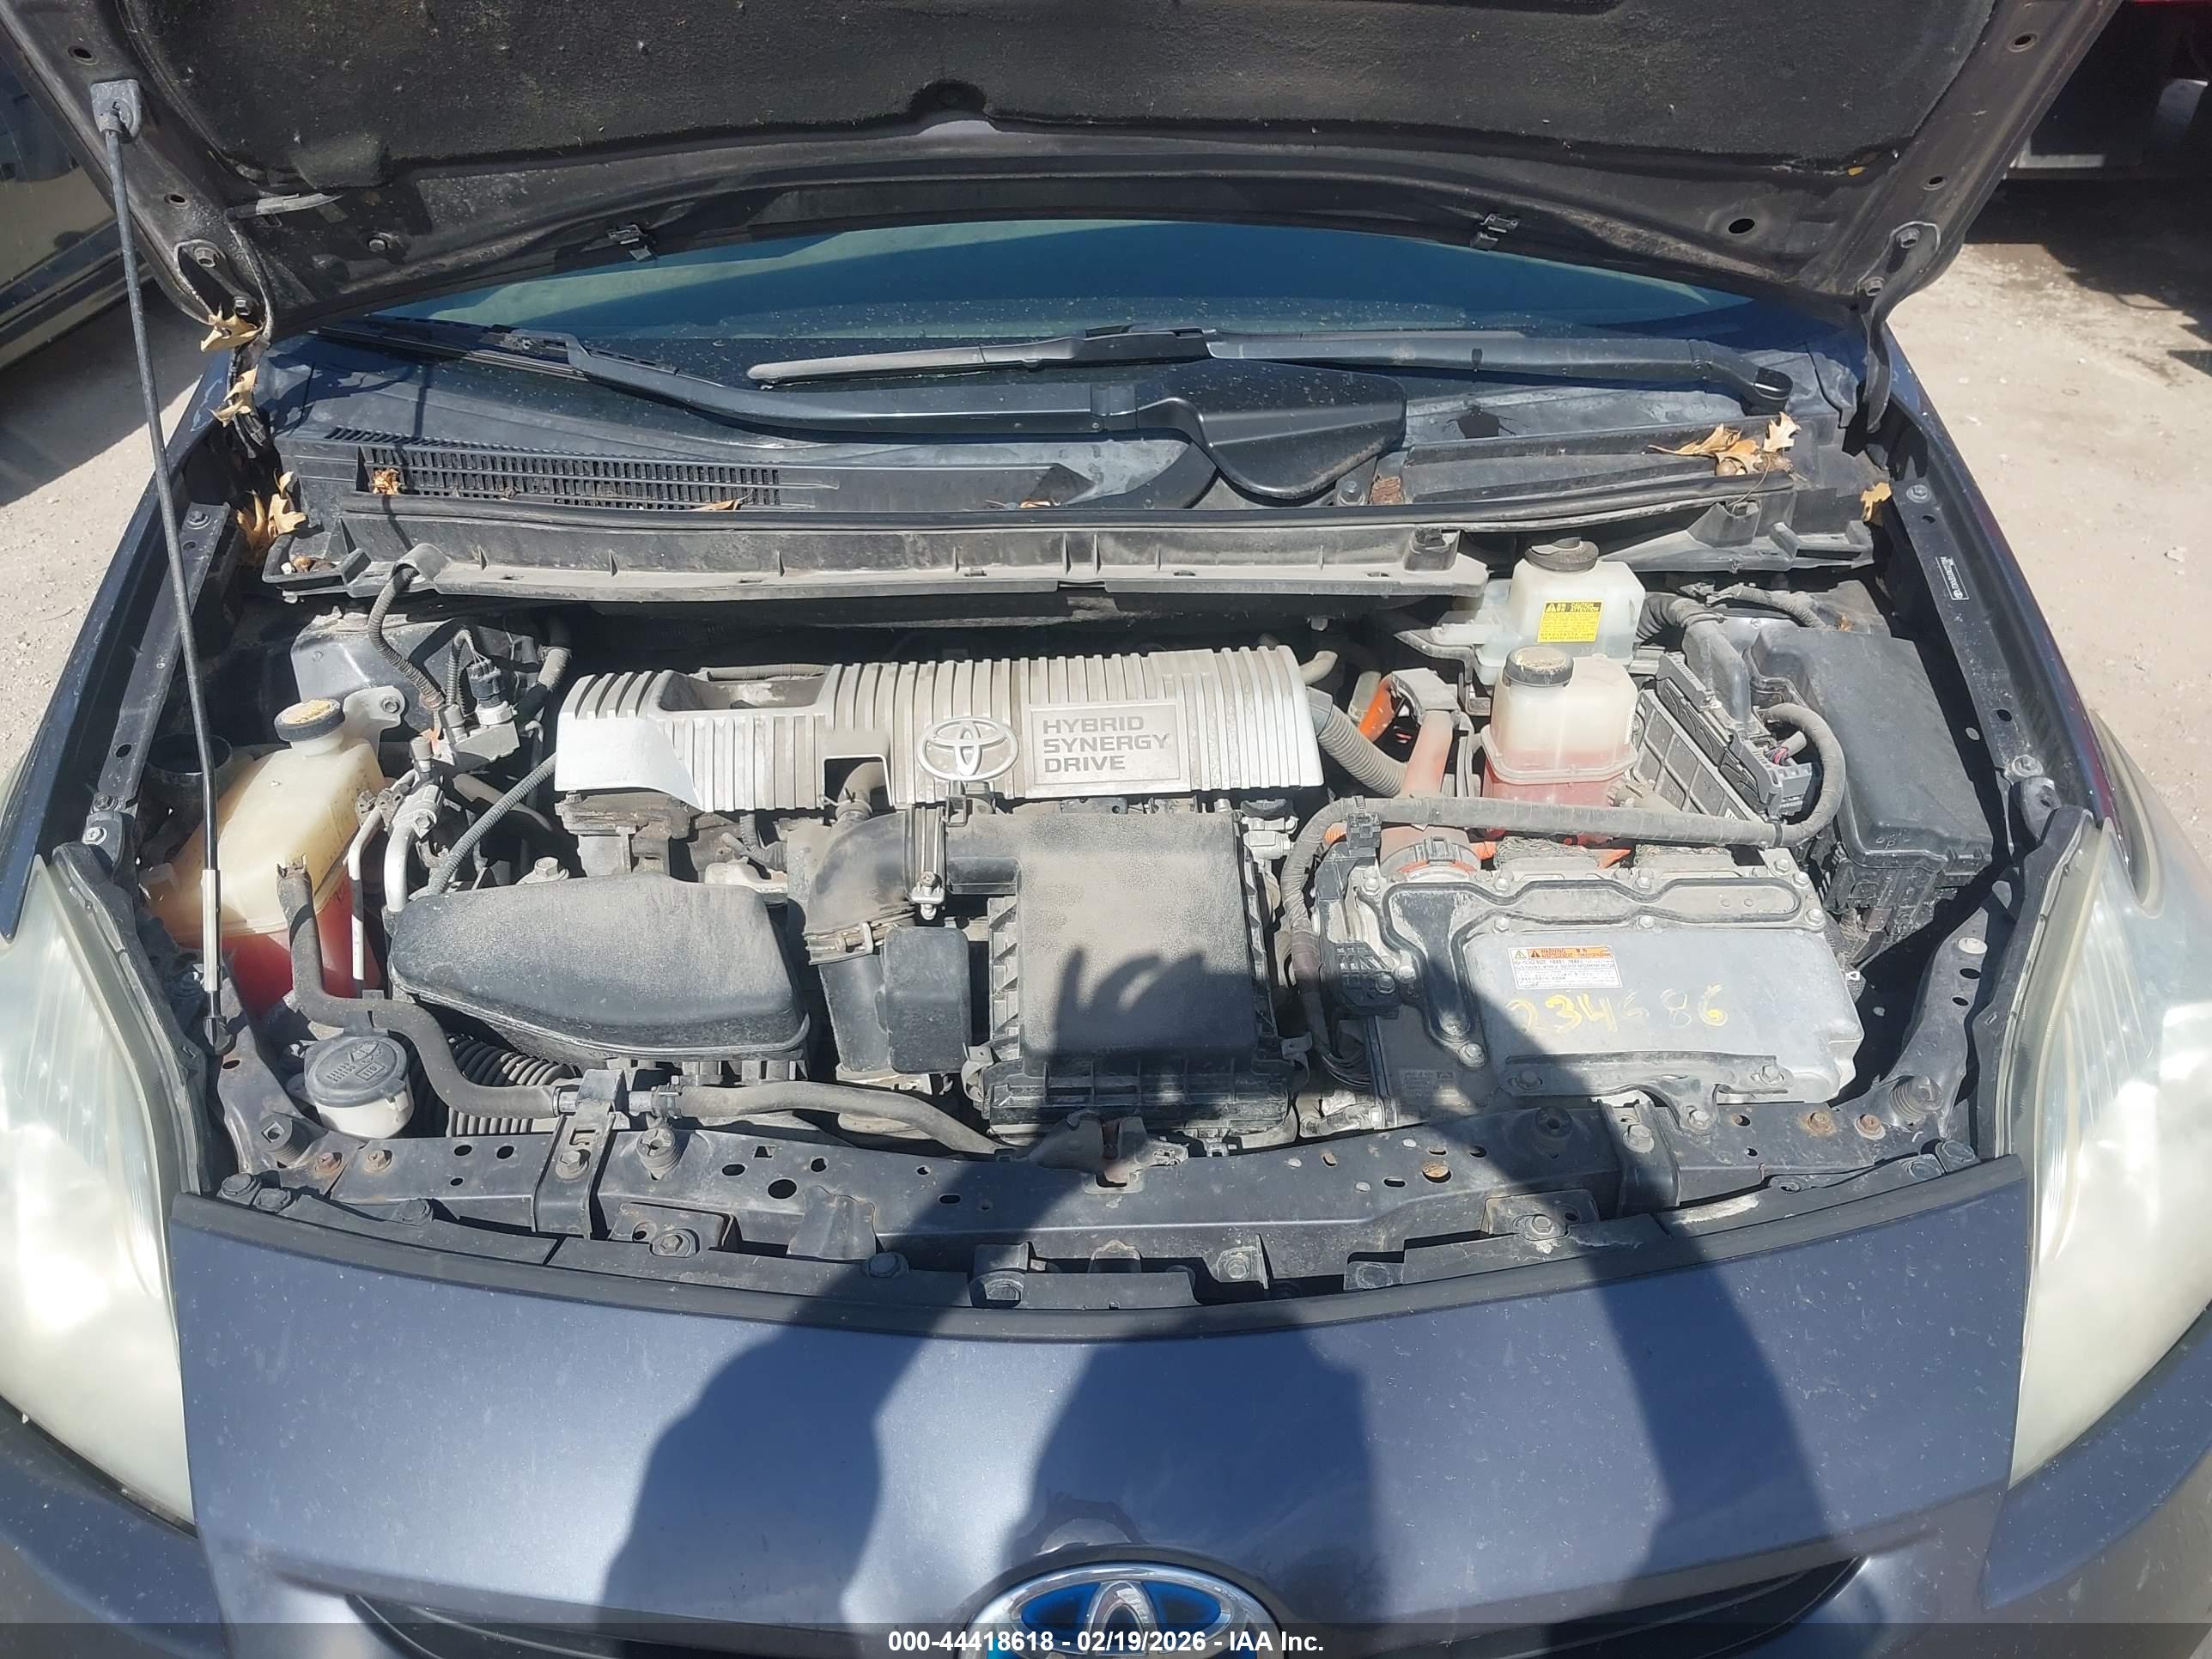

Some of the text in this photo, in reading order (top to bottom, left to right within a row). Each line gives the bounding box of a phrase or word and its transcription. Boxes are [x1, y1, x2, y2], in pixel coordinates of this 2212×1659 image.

[1043, 716, 1144, 734] HYBRID
[1043, 733, 1170, 754] SYNERGY
[1044, 756, 1126, 773] DRIVE
